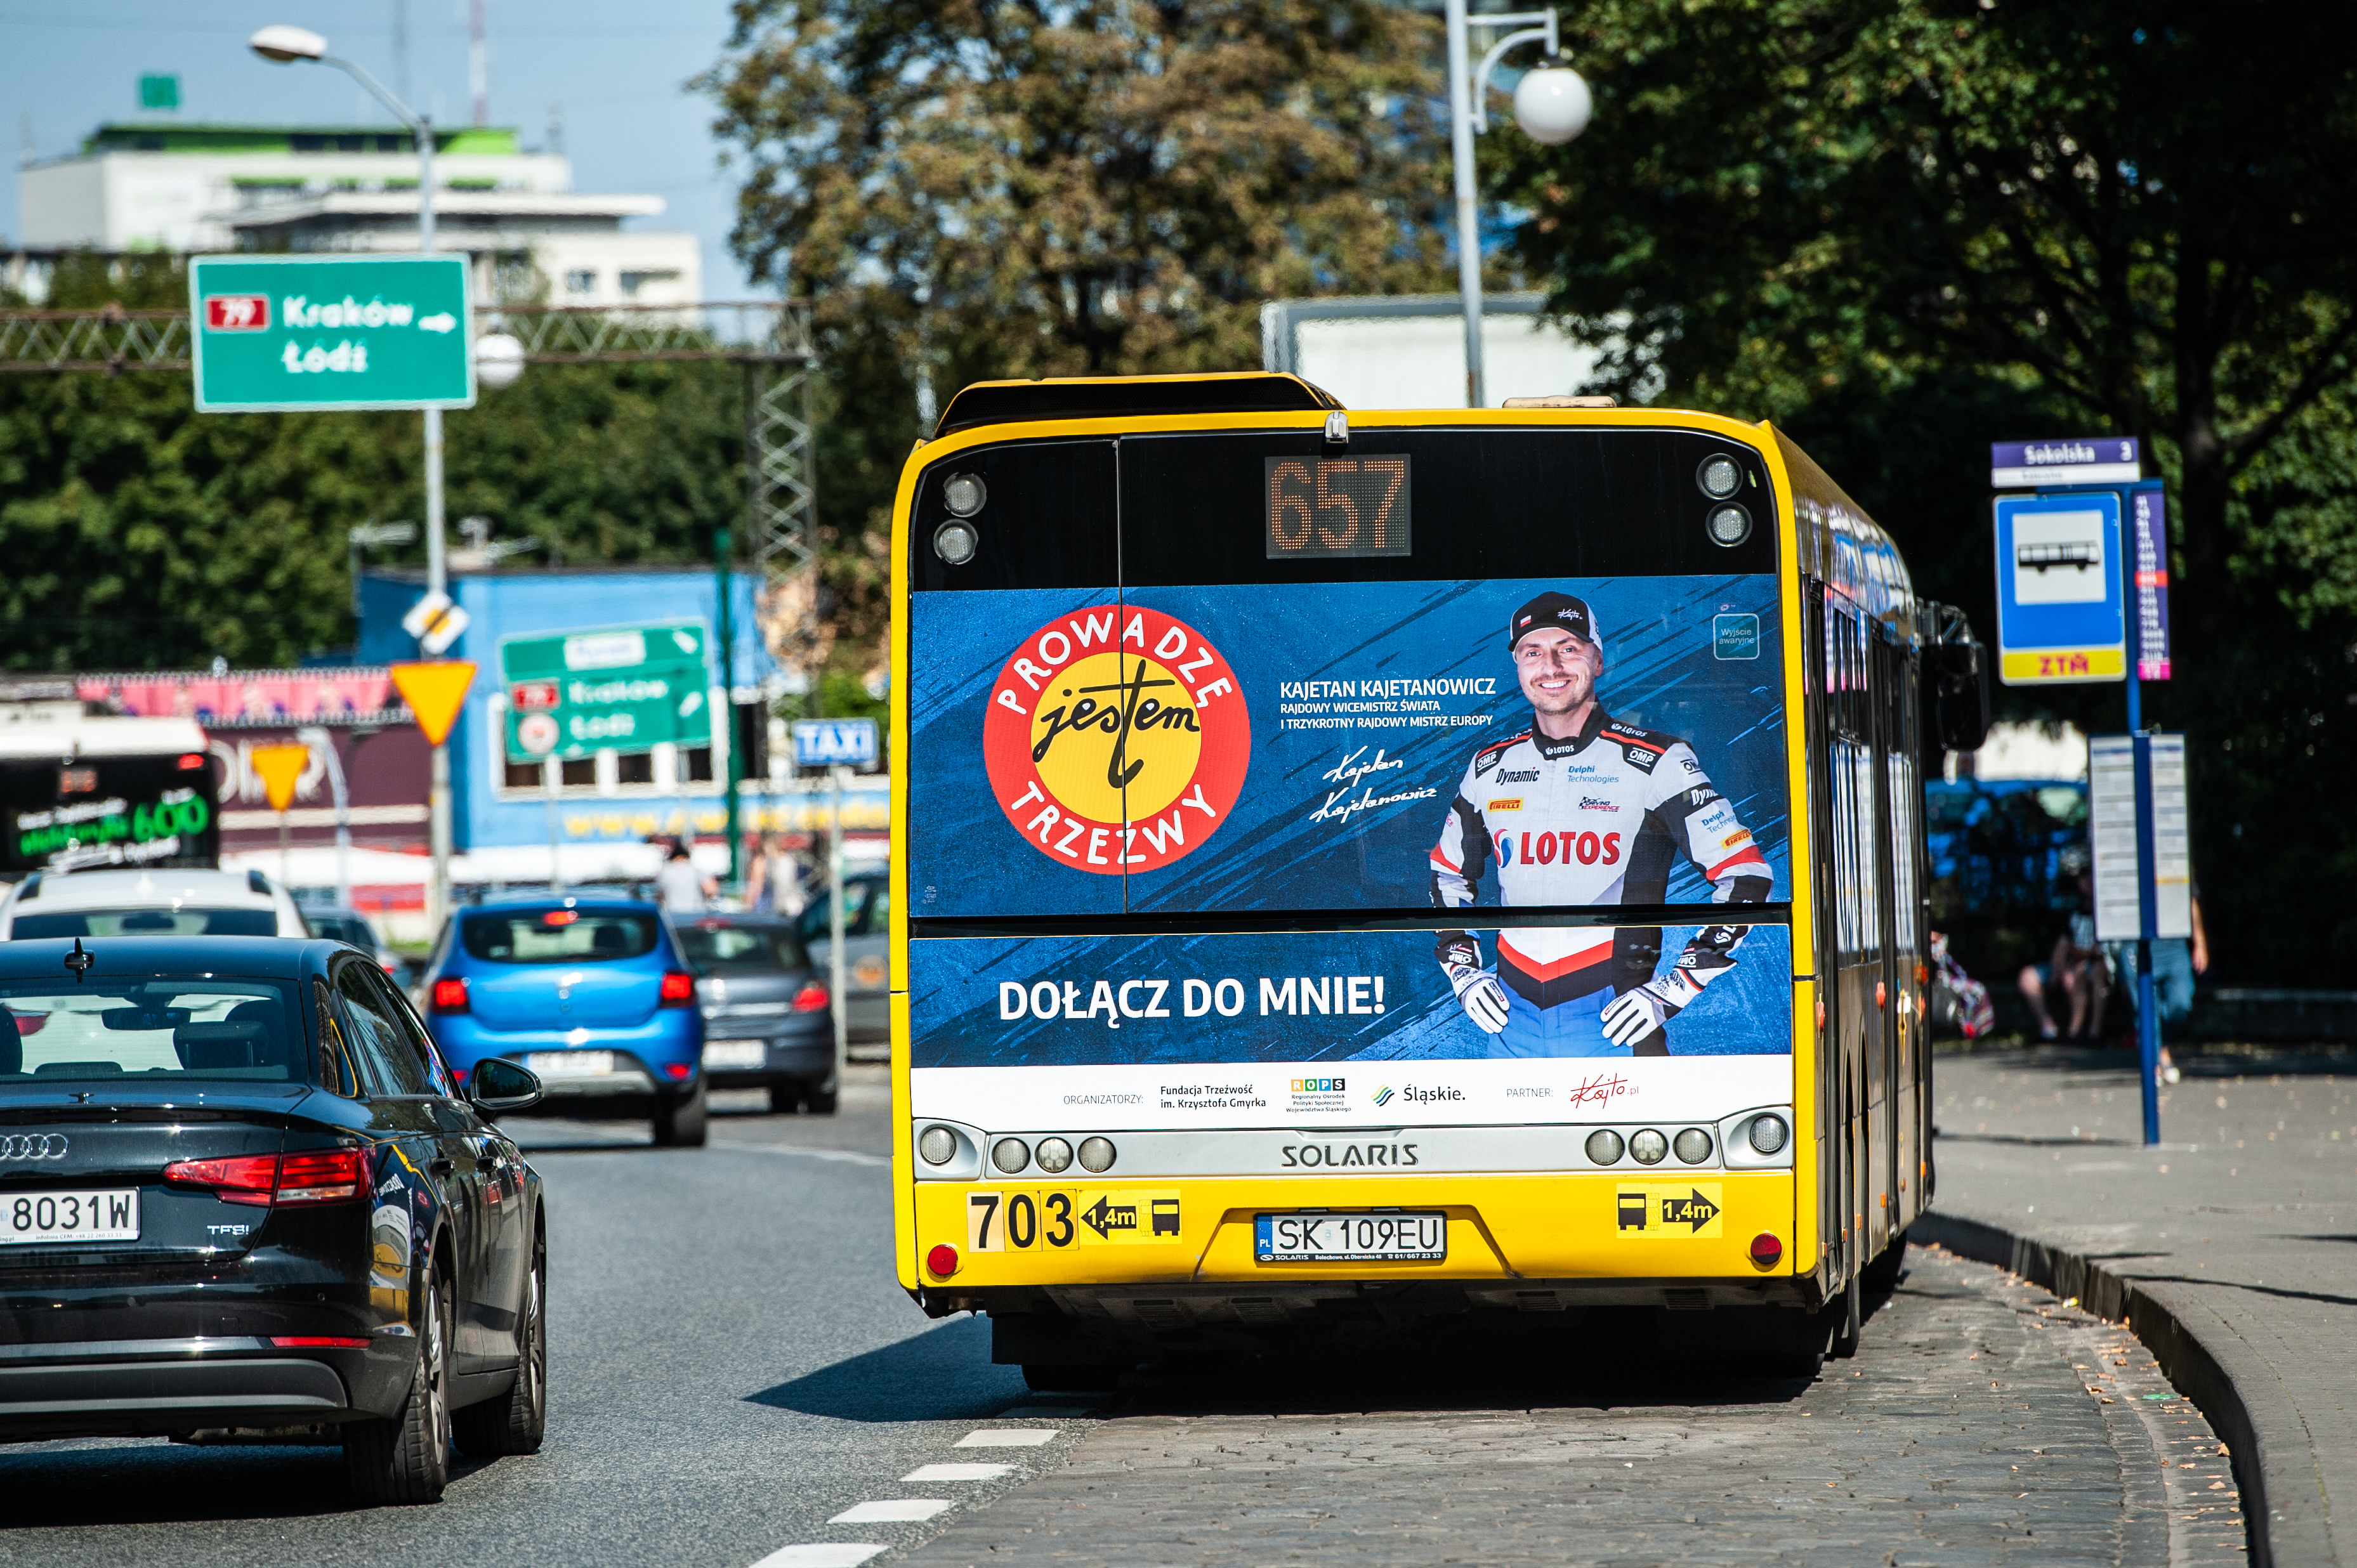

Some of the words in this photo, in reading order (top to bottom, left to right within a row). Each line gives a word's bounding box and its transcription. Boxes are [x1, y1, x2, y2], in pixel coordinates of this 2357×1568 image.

[283, 294, 414, 328] Kraków
[281, 338, 369, 374] Łódź
[2024, 442, 2095, 465] Sokolska
[2120, 441, 2132, 461] 3
[1271, 461, 1404, 550] 657
[1719, 637, 1755, 645] awaryjne
[1721, 628, 1752, 637] Wyjście
[997, 613, 1232, 714] PROWADZĘ
[2038, 653, 2089, 676] ZTM
[1280, 681, 1356, 701] KAJETAN
[1361, 678, 1496, 699] KAJETANOWICZ
[1280, 703, 1330, 715] RAJDOWY
[1333, 701, 1398, 713] WICEMISTRZ
[1400, 699, 1440, 711] ŚWIATA
[1032, 659, 1200, 789] jestem
[1280, 719, 1284, 729] I
[1287, 717, 1354, 729] TRZYKROTNY
[1357, 717, 1407, 729] RAJDOWY
[1410, 716, 1448, 727] MISTRZ
[1450, 715, 1493, 726] EUROPY
[1621, 726, 1648, 737] LOTOS
[799, 724, 872, 760] TAXI
[1554, 745, 1574, 754] LOTOS
[1322, 745, 1403, 787] Kajetan
[1477, 754, 1497, 768] OMP
[1629, 750, 1654, 763] OMP
[1495, 768, 1540, 786] Dynamic
[1568, 766, 1595, 774] Delphi
[1568, 775, 1619, 784] Technologies
[1309, 787, 1437, 823] Kajetanowicz
[1490, 800, 1520, 809] PIRELLI
[1011, 781, 1216, 865] TRZEŹWY
[1520, 831, 1620, 865] LOTOS
[1448, 953, 1472, 964] OMP
[1000, 981, 1169, 1029] DOŁĄCZ
[1184, 979, 1244, 1017] DO
[1260, 976, 1385, 1016] MNIE!
[1160, 1085, 1202, 1097] Fundacja
[1205, 1084, 1253, 1094] Trzeźwość
[1293, 1080, 1343, 1090] ROPS
[1404, 1083, 1466, 1104] Śląskie.
[1507, 1088, 1553, 1097] PARTNER:
[1063, 1095, 1143, 1104] ORGANIZATORZY:
[1160, 1099, 1175, 1108] im.
[1178, 1098, 1227, 1110] Krzysztofa
[1230, 1097, 1266, 1109] Gmyrka
[1282, 1144, 1419, 1168] SOLARIS
[13, 1194, 129, 1231] 8031W
[971, 1193, 1074, 1248] 703
[1087, 1208, 1136, 1229] 1,4m
[1664, 1201, 1712, 1222] 1,4m
[207, 1225, 249, 1236] TFSI
[1278, 1219, 1323, 1250] SK
[1340, 1218, 1437, 1250] 109EU
[1260, 1239, 1271, 1247] PL
